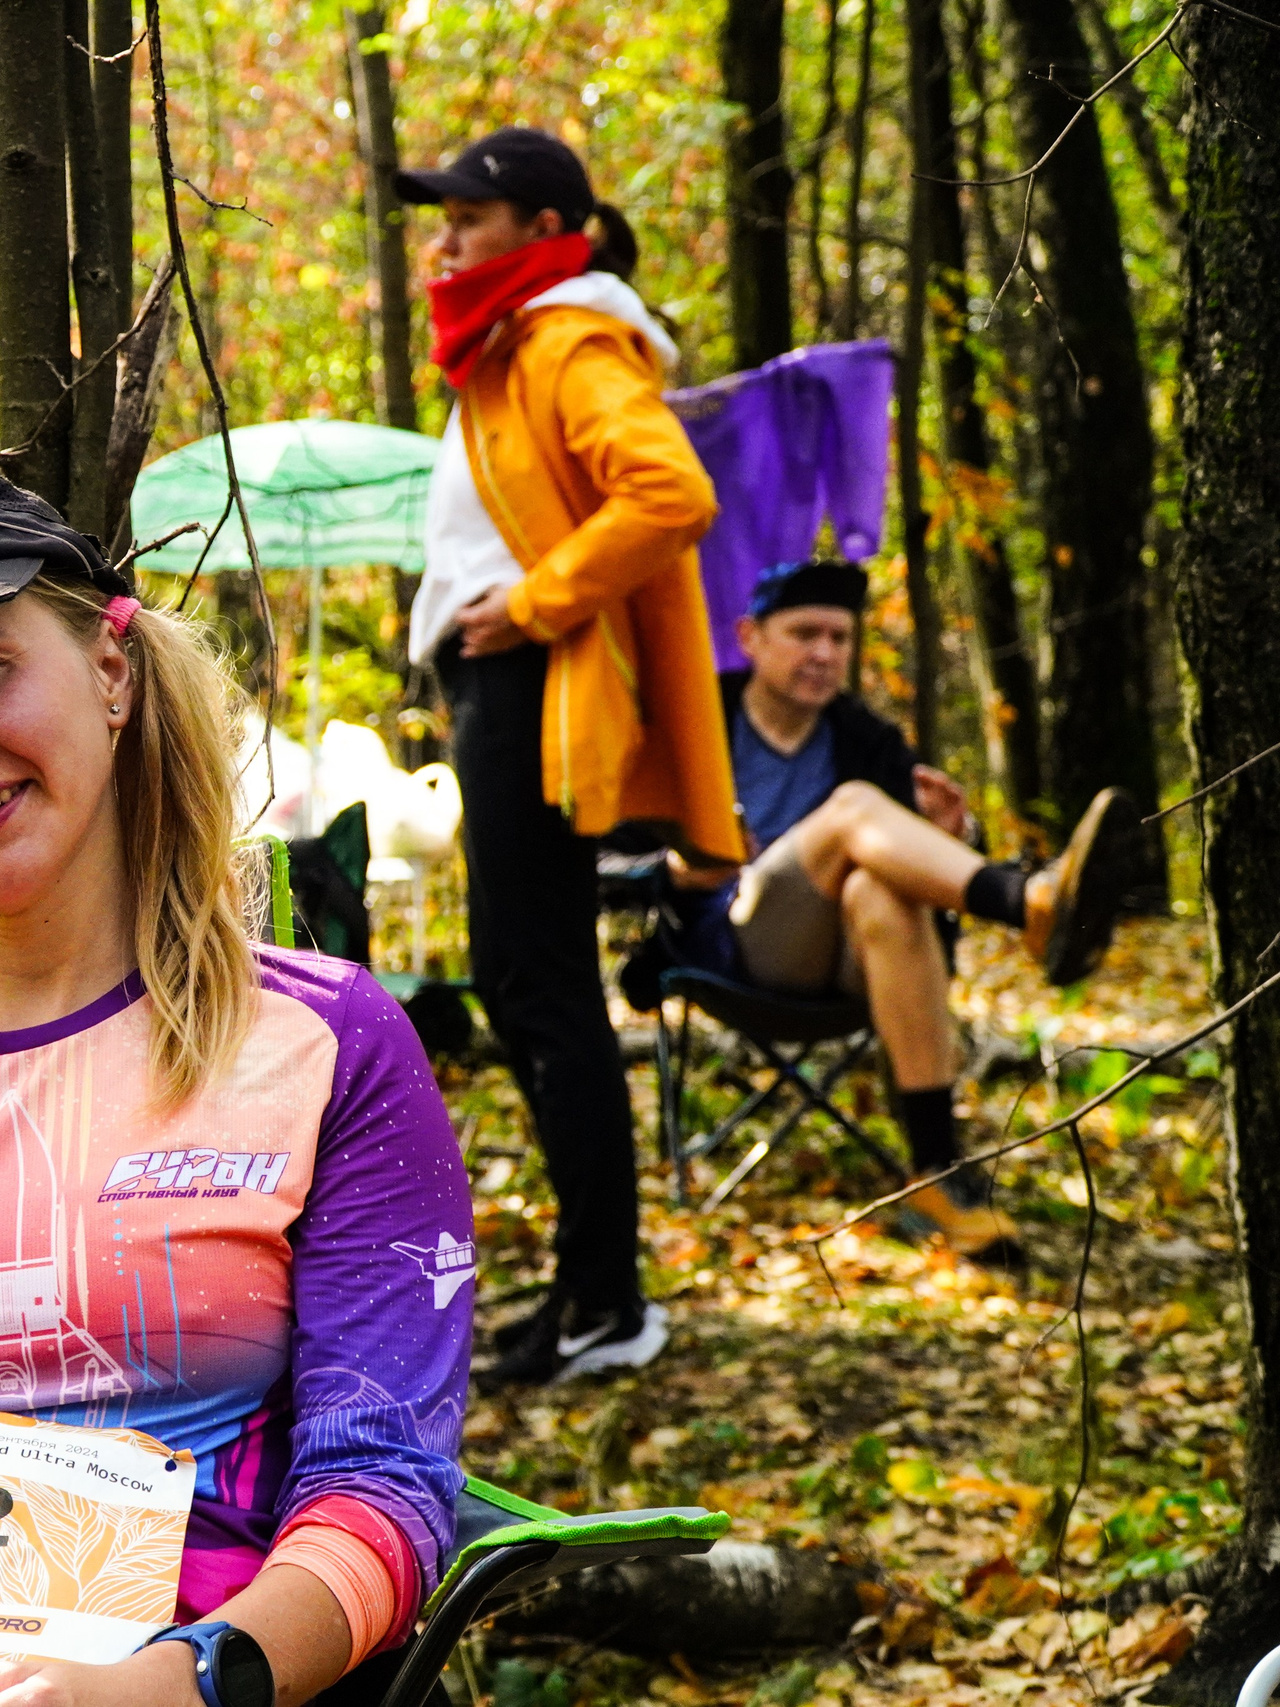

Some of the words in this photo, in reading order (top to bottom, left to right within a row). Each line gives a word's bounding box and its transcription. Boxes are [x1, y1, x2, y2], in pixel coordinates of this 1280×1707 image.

[98, 1187, 198, 1202] СПОРТИВНЫЙ
[201, 1188, 240, 1198] КЛУБ
[65, 1443, 99, 1459] 2024
[21, 1449, 76, 1469] Ultra
[86, 1462, 154, 1493] Moscow
